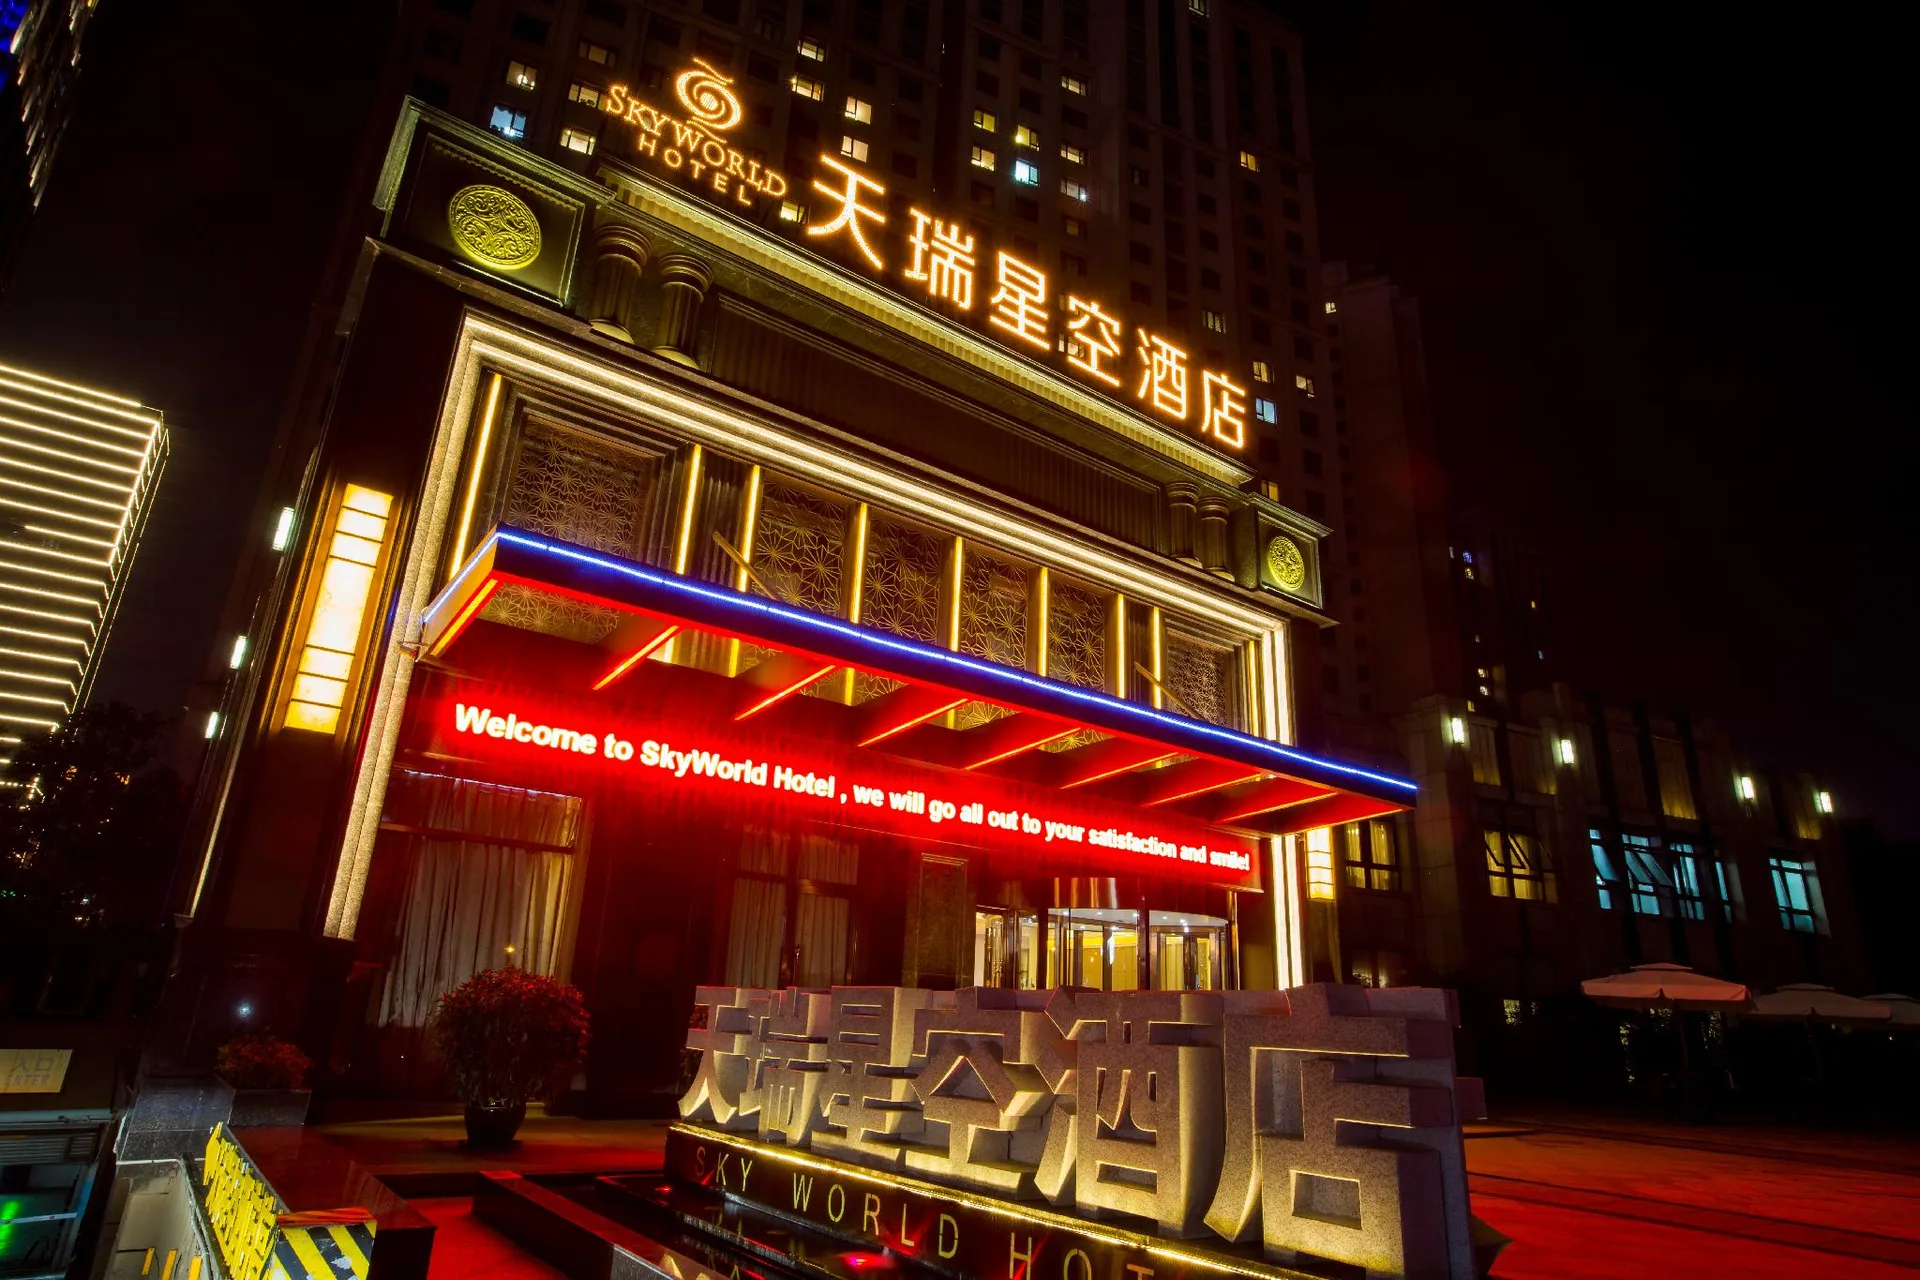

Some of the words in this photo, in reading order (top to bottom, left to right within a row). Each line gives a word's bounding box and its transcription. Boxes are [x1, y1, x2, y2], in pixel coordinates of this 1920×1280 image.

[639, 132, 752, 205] HOTEL
[806, 153, 1246, 449] 天瑞星空酒店
[455, 703, 597, 755] Welcome
[604, 733, 634, 761] to
[640, 739, 768, 786] SkyWorld
[773, 765, 835, 798] Hotel
[852, 784, 884, 806] we
[889, 790, 925, 814] will
[929, 799, 956, 823] go
[960, 802, 983, 824] all
[988, 810, 1018, 831] out
[1022, 812, 1041, 834] to
[1045, 820, 1085, 842] your
[1088, 828, 1177, 859] satisfaction
[1180, 845, 1207, 863] and
[1210, 850, 1250, 871] smile!
[9, 1057, 55, 1073] 入口
[678, 983, 1430, 1275] 天瑞星空酒店
[694, 1146, 754, 1192] SKY
[792, 1172, 960, 1259] WORLD
